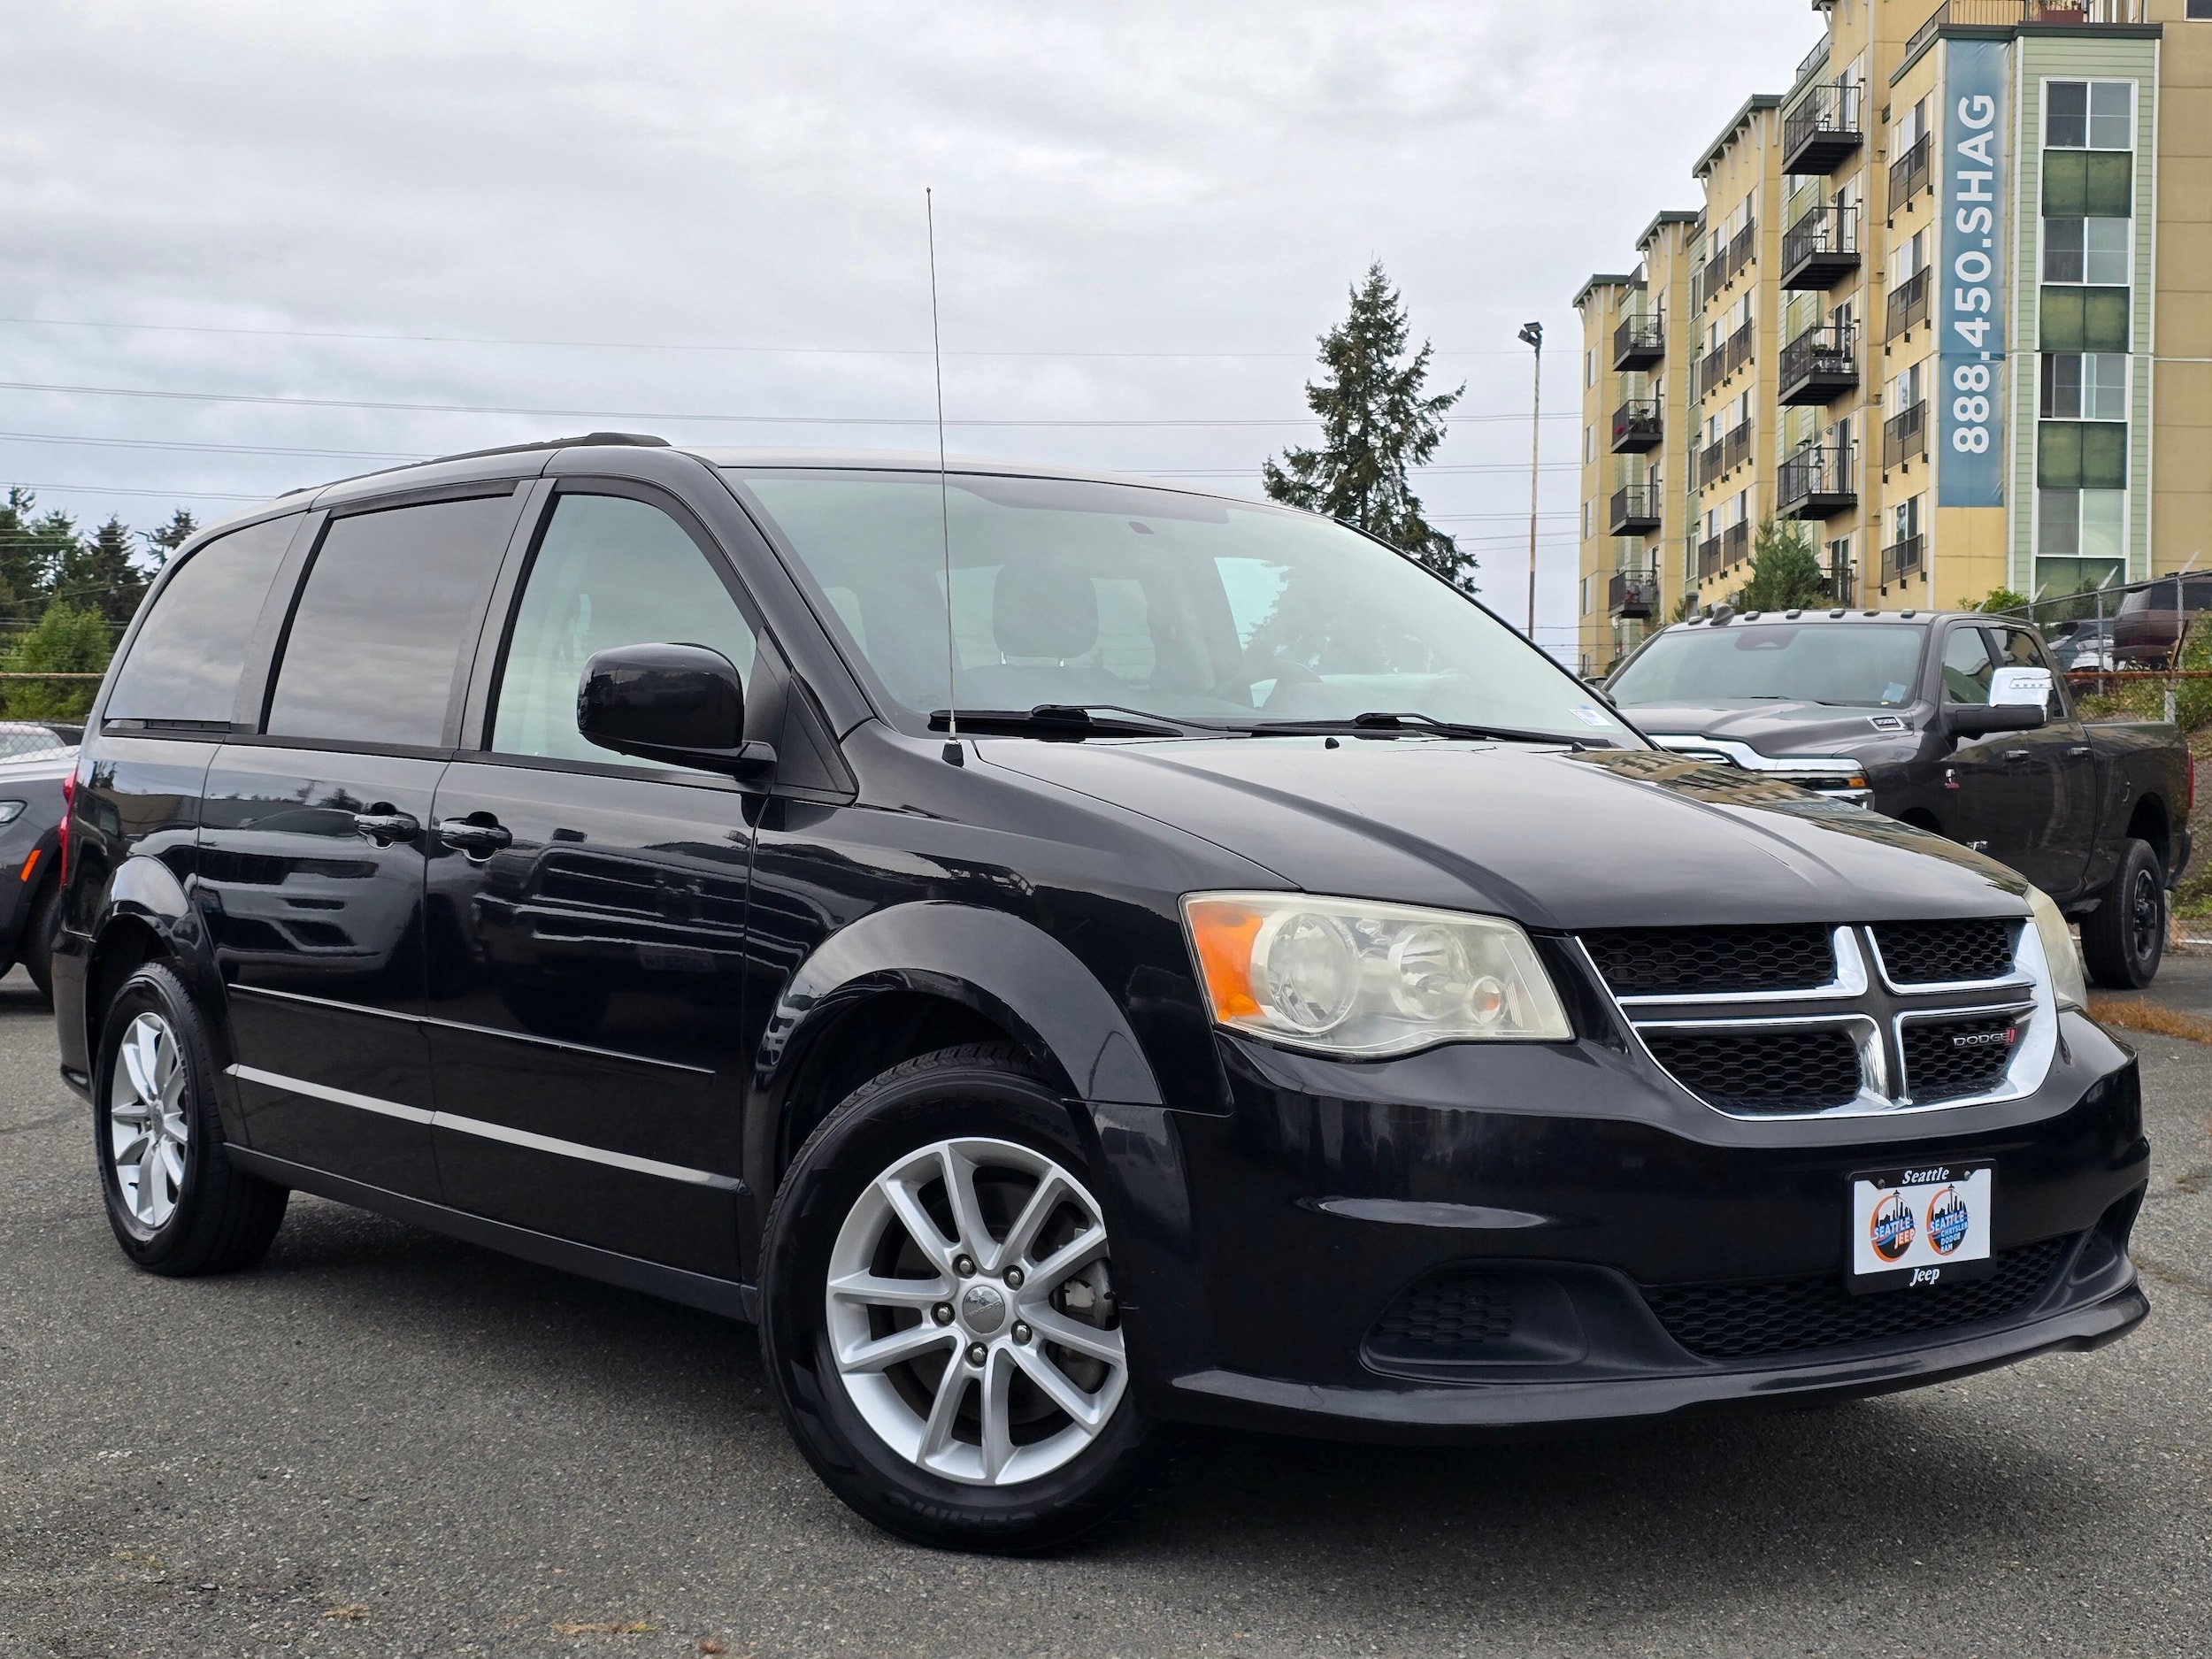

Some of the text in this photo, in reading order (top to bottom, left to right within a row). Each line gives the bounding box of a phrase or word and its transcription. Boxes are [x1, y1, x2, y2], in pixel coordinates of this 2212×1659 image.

[1953, 95, 1995, 454] 888.450.SHAG
[1953, 1032, 2009, 1047] DODGE
[1902, 1167, 1949, 1185] Seattle
[1874, 1217, 1911, 1240] SEATTLE
[1930, 1210, 1965, 1233] SEATTLE
[1940, 1222, 1969, 1237] CHRYSLER
[1893, 1228, 1915, 1249] JEEP
[1940, 1233, 1961, 1247] DODGE
[1909, 1268, 1940, 1286] Jeep
